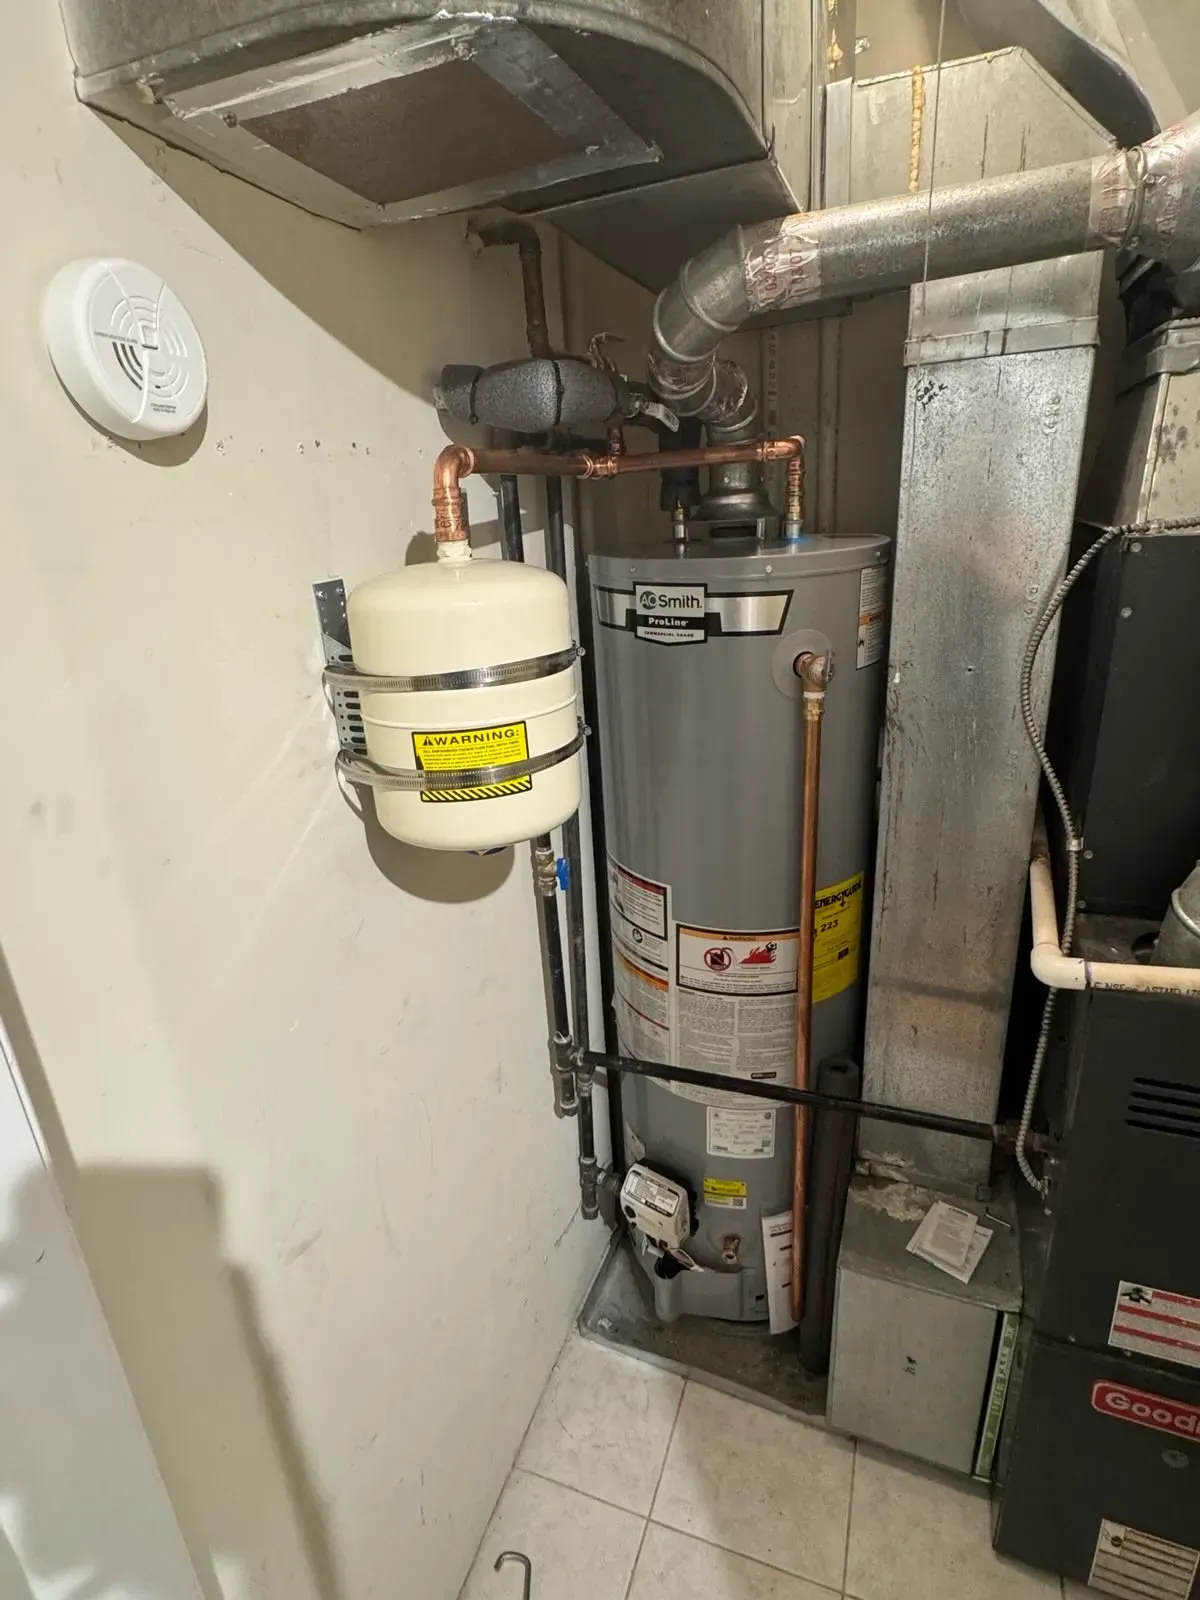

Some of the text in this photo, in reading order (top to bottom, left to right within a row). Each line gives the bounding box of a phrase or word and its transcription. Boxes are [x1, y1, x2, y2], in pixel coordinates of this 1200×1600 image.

[648, 617, 688, 627] ProLine
[434, 729, 519, 745] WARNING:
[820, 919, 838, 932] 223
[1105, 1392, 1200, 1433] Good
